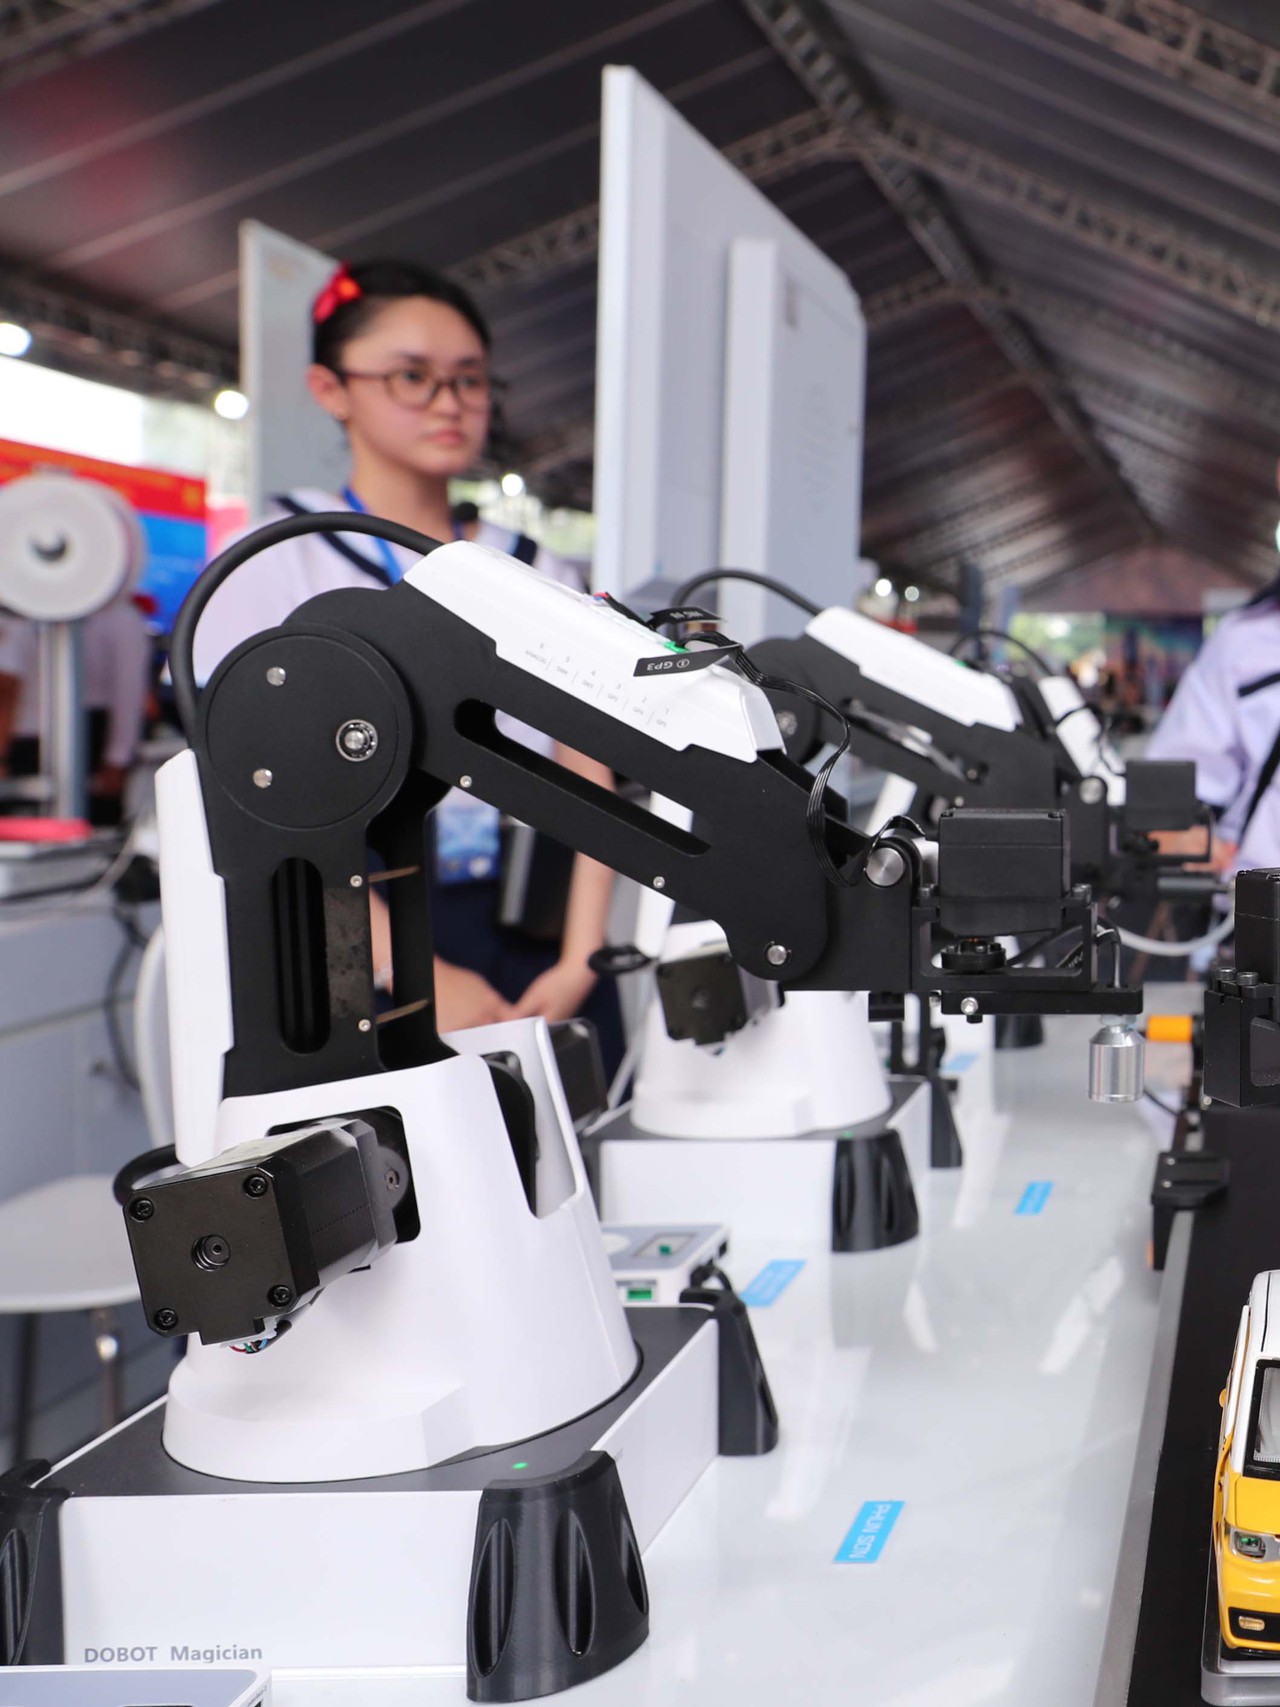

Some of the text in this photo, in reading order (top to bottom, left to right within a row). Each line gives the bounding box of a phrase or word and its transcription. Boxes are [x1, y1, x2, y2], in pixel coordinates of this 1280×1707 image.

[646, 661, 673, 671] GP3
[84, 1644, 263, 1664] DOBOT Magician
